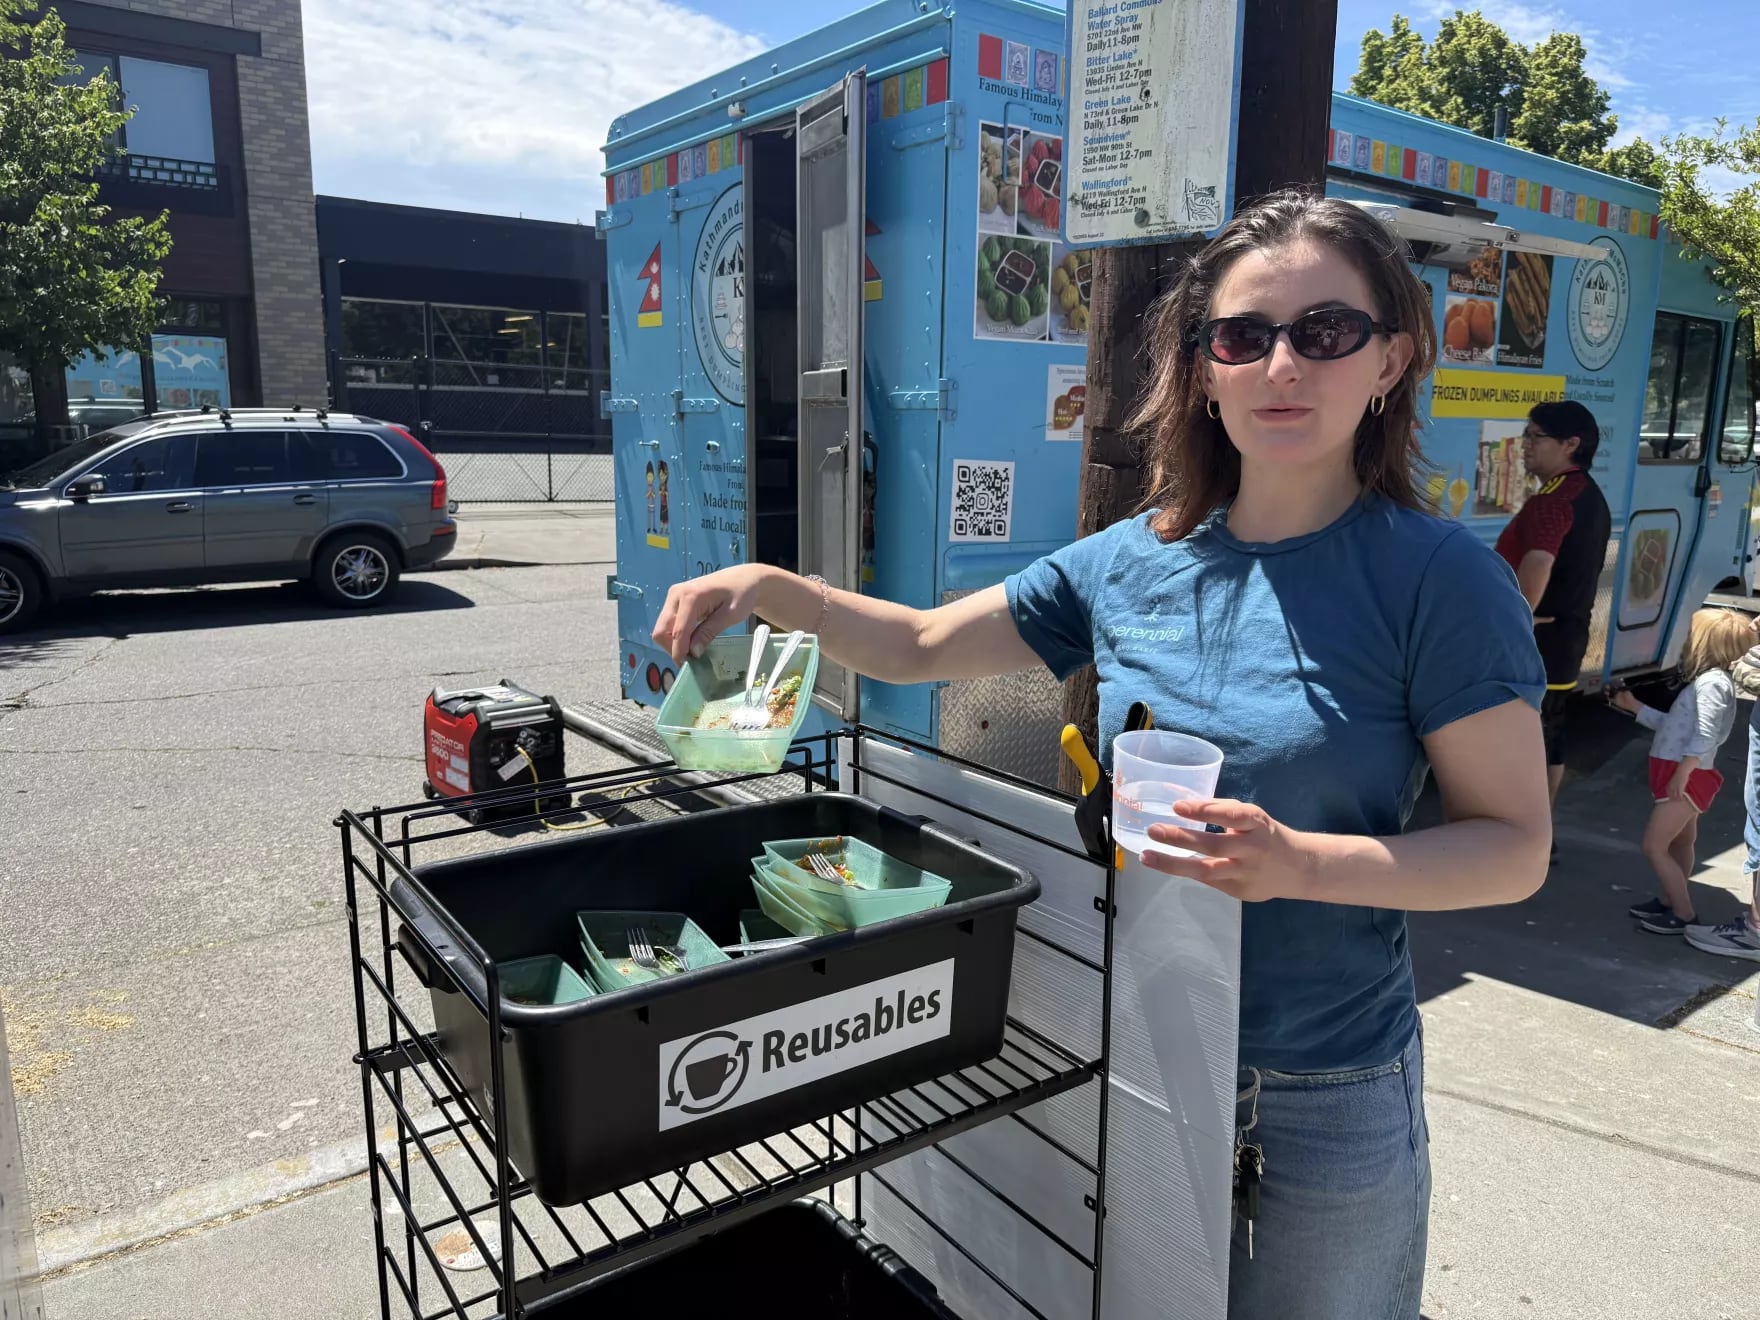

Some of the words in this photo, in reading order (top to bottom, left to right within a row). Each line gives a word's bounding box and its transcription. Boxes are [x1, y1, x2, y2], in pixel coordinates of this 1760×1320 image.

[1088, 3, 1118, 19] Ballard
[1088, 19, 1112, 31] Water
[1115, 14, 1139, 26] Spray
[1104, 28, 1119, 37] 22nd
[1131, 23, 1143, 31] NW
[1086, 55, 1111, 68] Bitter
[1085, 73, 1116, 88] Wed-Fri
[1119, 69, 1152, 82] 12-7pm
[979, 77, 1018, 98] Famous
[1085, 99, 1108, 110] Green
[1111, 95, 1131, 106] Lake
[1090, 110, 1103, 118] 73rd
[1111, 107, 1128, 115] Green
[1130, 104, 1143, 112] Lake
[1084, 119, 1103, 130] Daily
[1106, 114, 1139, 127] 11-8pm
[1100, 144, 1109, 152] NW
[1083, 153, 1117, 166] Sat-Mon
[1120, 149, 1152, 161] 12-7pm
[1098, 188, 1129, 198] Wallingford
[1081, 198, 1110, 211] Wed-Fri
[1114, 195, 1146, 207] 12-7pm
[1081, 211, 1096, 219] Closed
[1451, 273, 1473, 289] Vegan
[1474, 277, 1498, 293] Pakora
[1444, 344, 1472, 360] Cheese
[1472, 347, 1492, 362] Balls
[1432, 385, 1467, 401] FROZEN
[1469, 387, 1520, 403] DUMPLINGS
[1521, 390, 1565, 403] AVAILABLE
[703, 492, 728, 509] Made
[701, 516, 717, 530] and
[761, 989, 941, 1074] Reusables
